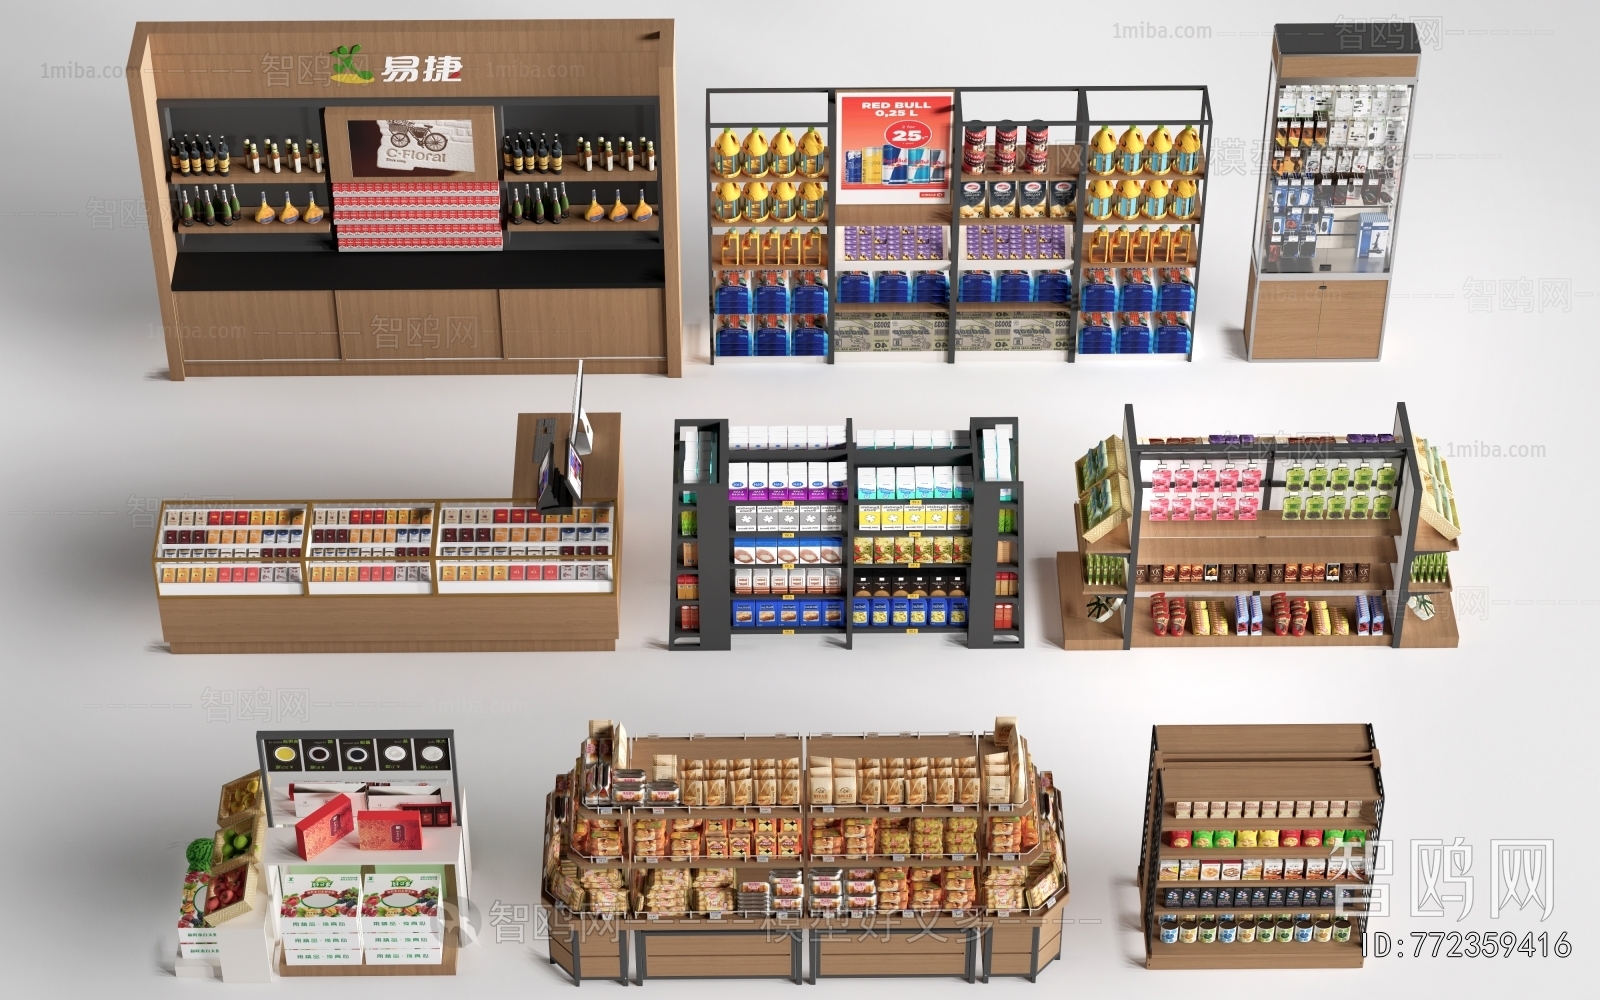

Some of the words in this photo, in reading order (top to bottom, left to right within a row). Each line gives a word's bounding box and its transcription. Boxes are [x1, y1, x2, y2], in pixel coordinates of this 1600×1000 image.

[381, 55, 463, 83] 易捷
[874, 110, 906, 118] 0,25
[386, 148, 446, 162] C-Floral
